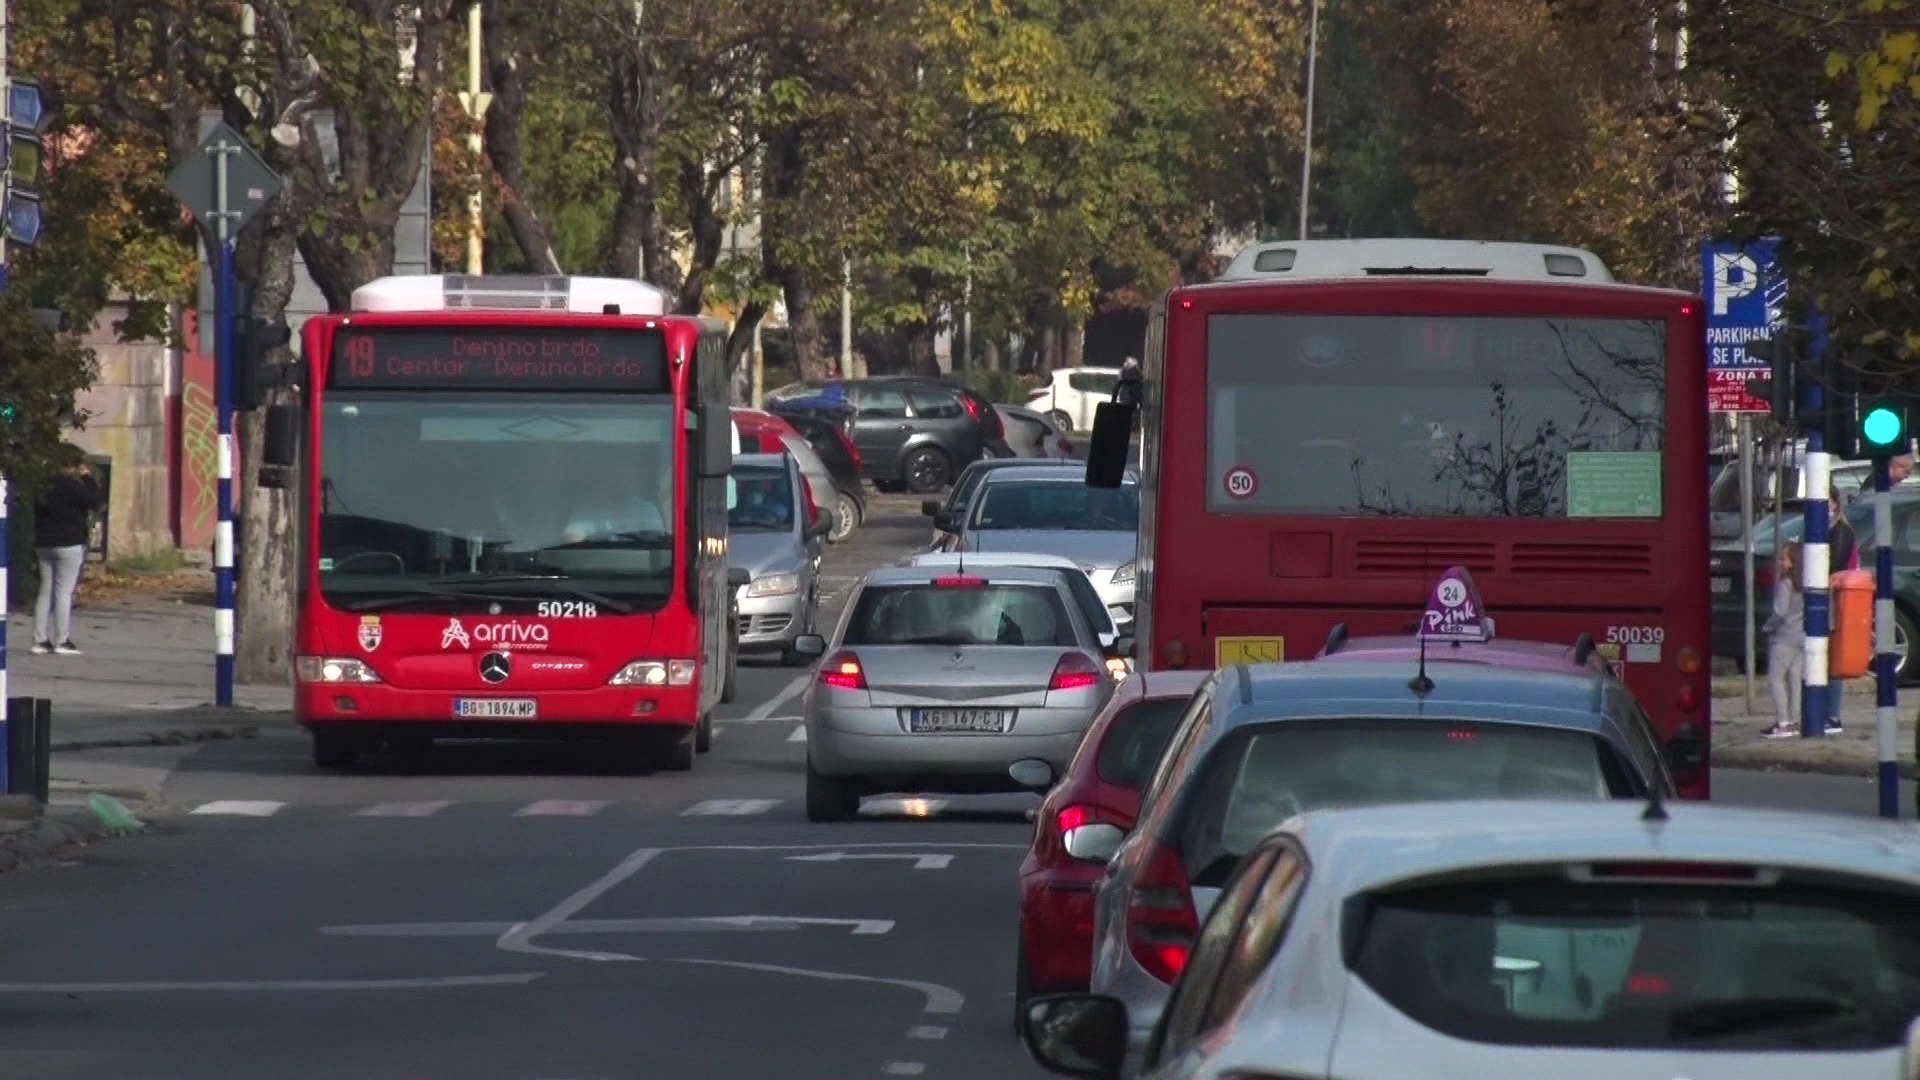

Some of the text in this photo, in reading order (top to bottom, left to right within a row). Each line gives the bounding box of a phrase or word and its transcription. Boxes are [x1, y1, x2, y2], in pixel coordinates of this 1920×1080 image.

[1714, 253, 1757, 315] P
[1706, 327, 1773, 343] PARKIRAN
[453, 336, 600, 357] Denino brdo
[343, 335, 375, 377] 19
[1713, 348, 1729, 365] SE
[387, 355, 466, 377] Centar
[495, 356, 577, 377] Denino
[582, 356, 641, 377] brdo
[1716, 371, 1756, 381] ZONA
[1232, 475, 1250, 491] 50
[1443, 586, 1459, 602] 24
[538, 601, 597, 618] 50218
[1425, 600, 1477, 631] Pink
[474, 620, 549, 642] arriva
[1606, 625, 1665, 644] 50039
[462, 702, 477, 715] BG
[922, 710, 940, 725] KG
